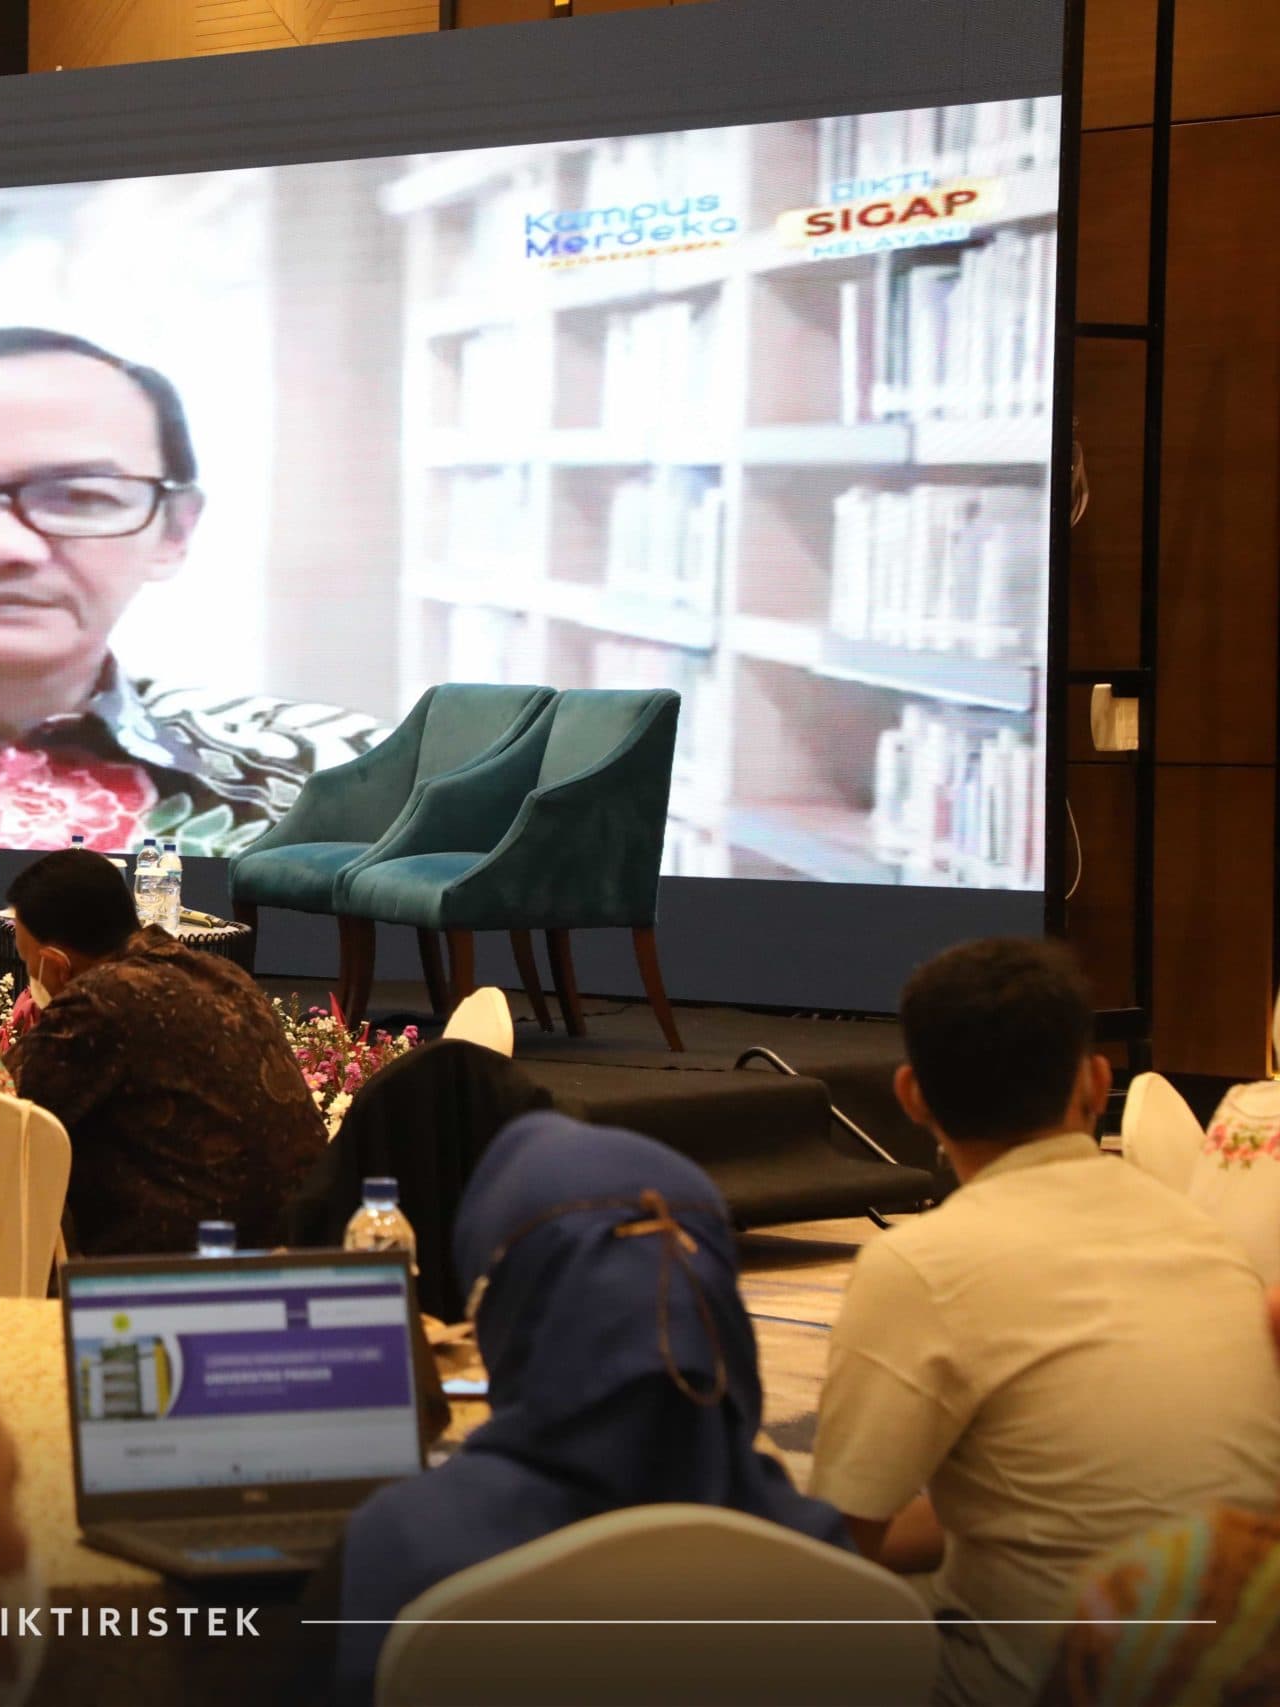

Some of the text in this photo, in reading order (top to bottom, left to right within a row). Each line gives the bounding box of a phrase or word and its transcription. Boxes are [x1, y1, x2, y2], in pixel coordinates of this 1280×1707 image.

[525, 194, 721, 235] Kampus
[805, 190, 978, 236] SIGAP
[526, 217, 738, 258] Merdeka
